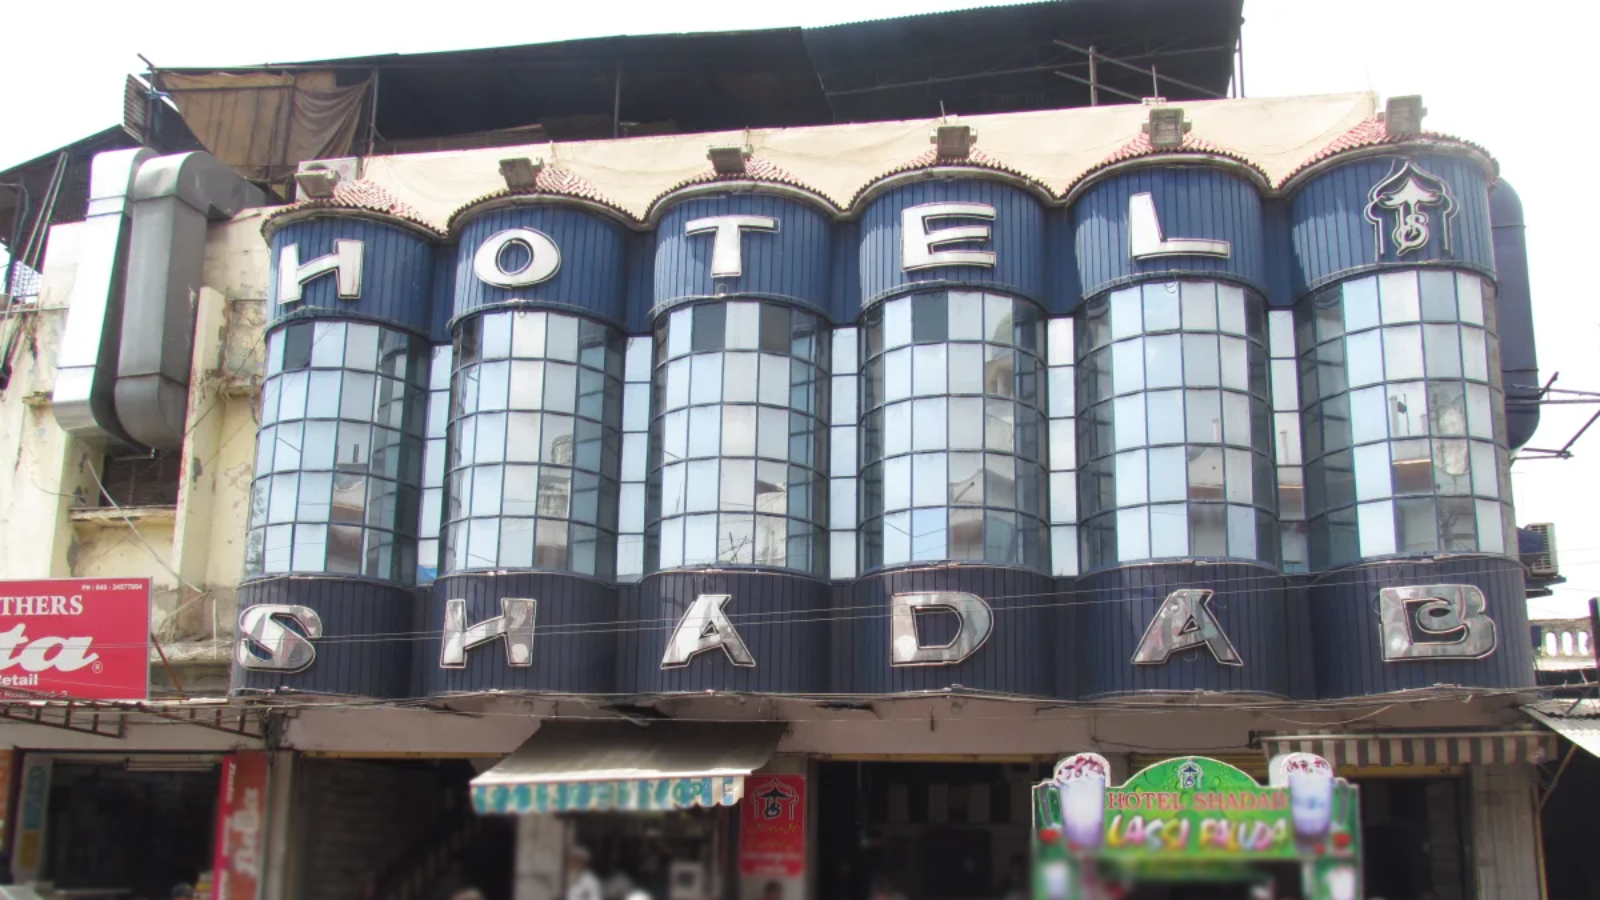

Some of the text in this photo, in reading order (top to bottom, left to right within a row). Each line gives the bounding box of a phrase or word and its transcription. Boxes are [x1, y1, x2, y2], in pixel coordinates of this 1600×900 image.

[278, 191, 1232, 305] HOTEL
[236, 583, 1497, 673] SHADAB
[0, 673, 38, 686] etail
[1107, 791, 1287, 812] HOTEL SHADAB
